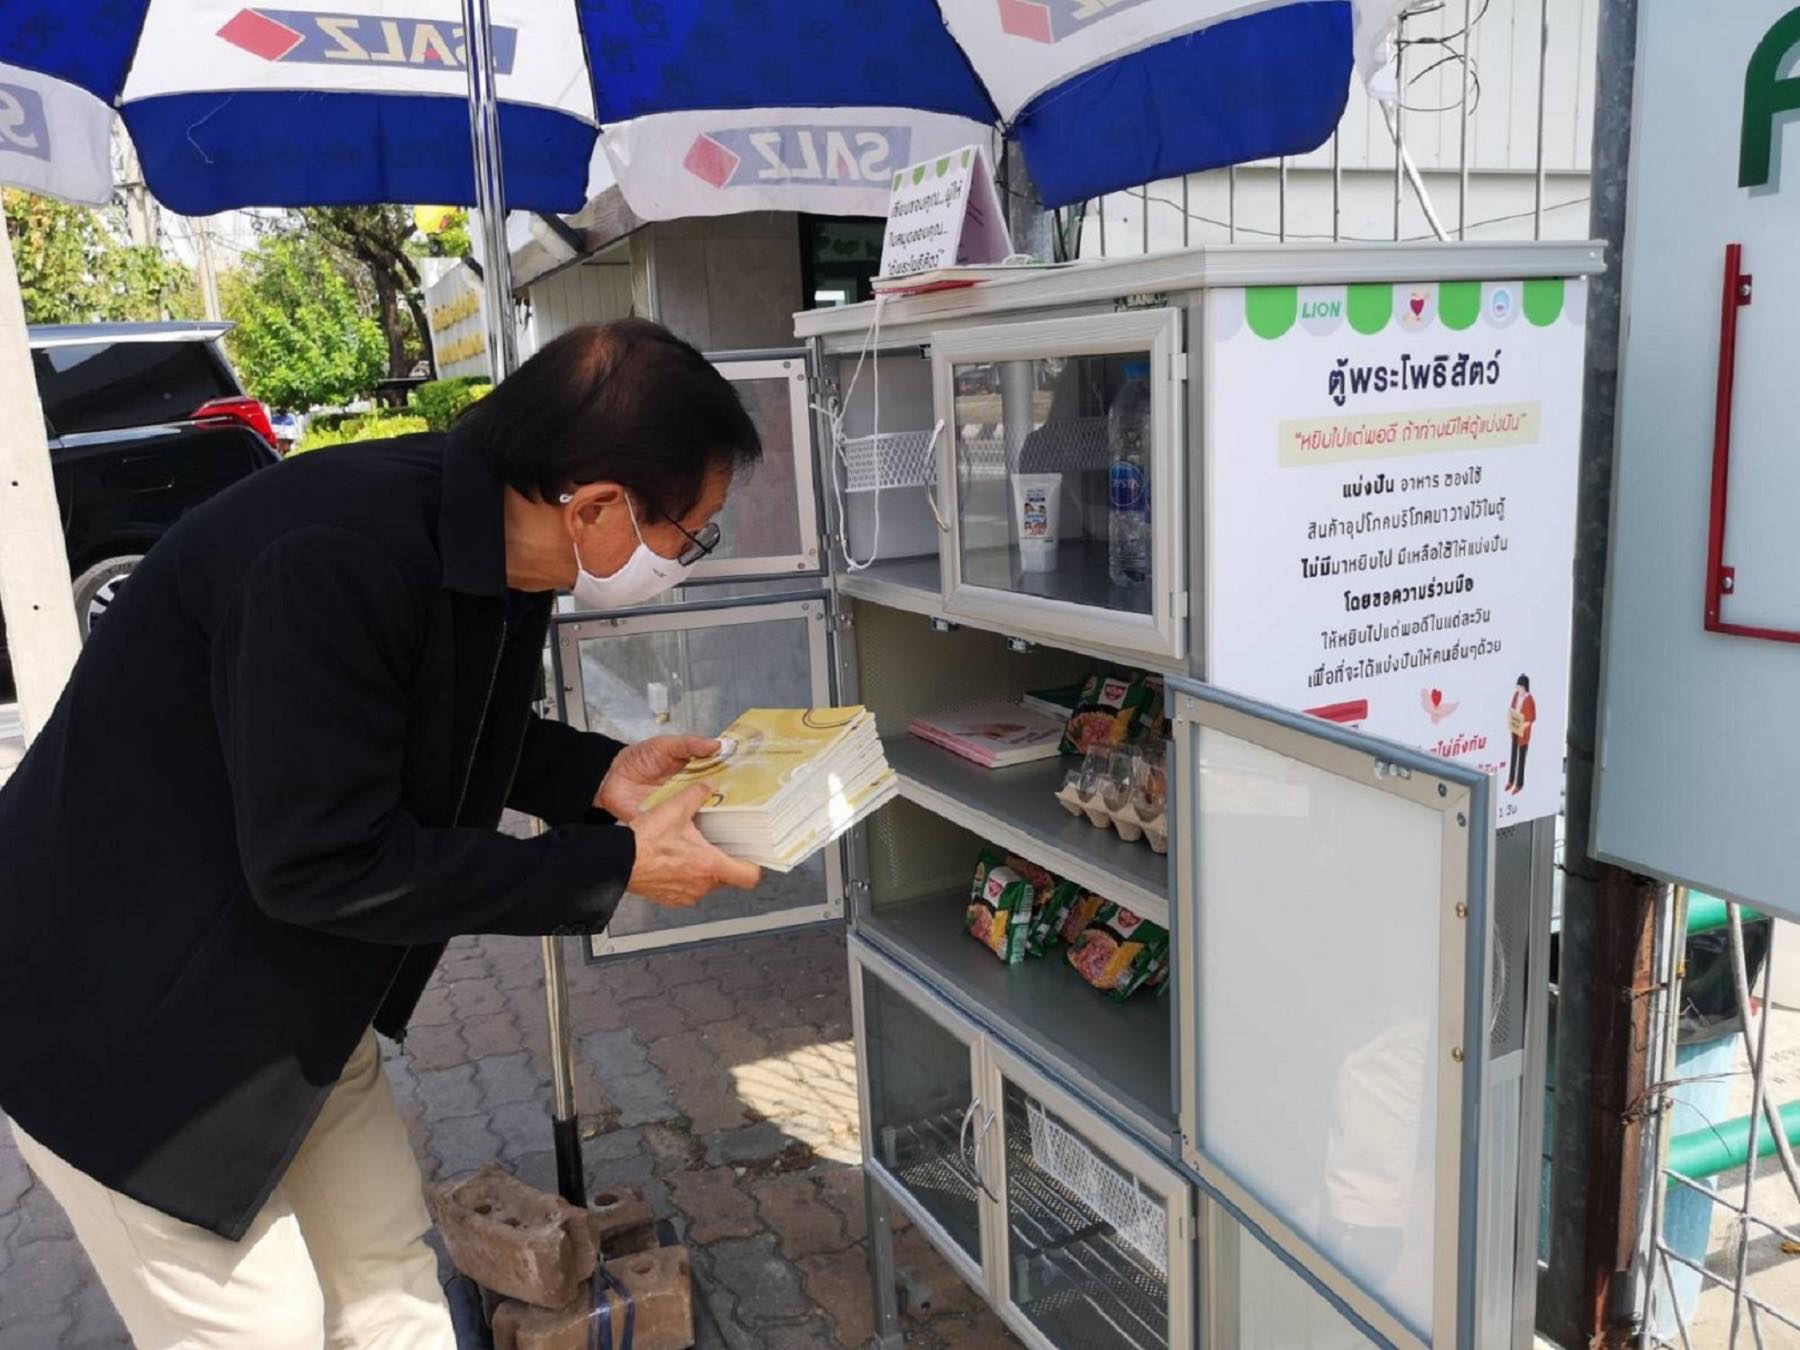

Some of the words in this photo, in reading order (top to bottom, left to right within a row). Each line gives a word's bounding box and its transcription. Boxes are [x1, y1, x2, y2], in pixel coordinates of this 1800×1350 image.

[1301, 301, 1341, 319] LION
[1328, 349, 1502, 407] ตู้พระโพธิสัตว์
[1342, 473, 1395, 499] แบ่งปัน
[1401, 474, 1440, 492] อาหาร
[1444, 465, 1483, 487] ของใช้
[1343, 573, 1474, 612] โดยขอความร่วมมือ
[1321, 608, 1491, 650] ให้หยิบไปแต่พอดีในแต่ละวัน
[1307, 638, 1501, 688] เพื่อที่จะได้แบ่งปันให้คนอื่นๆด้วย
